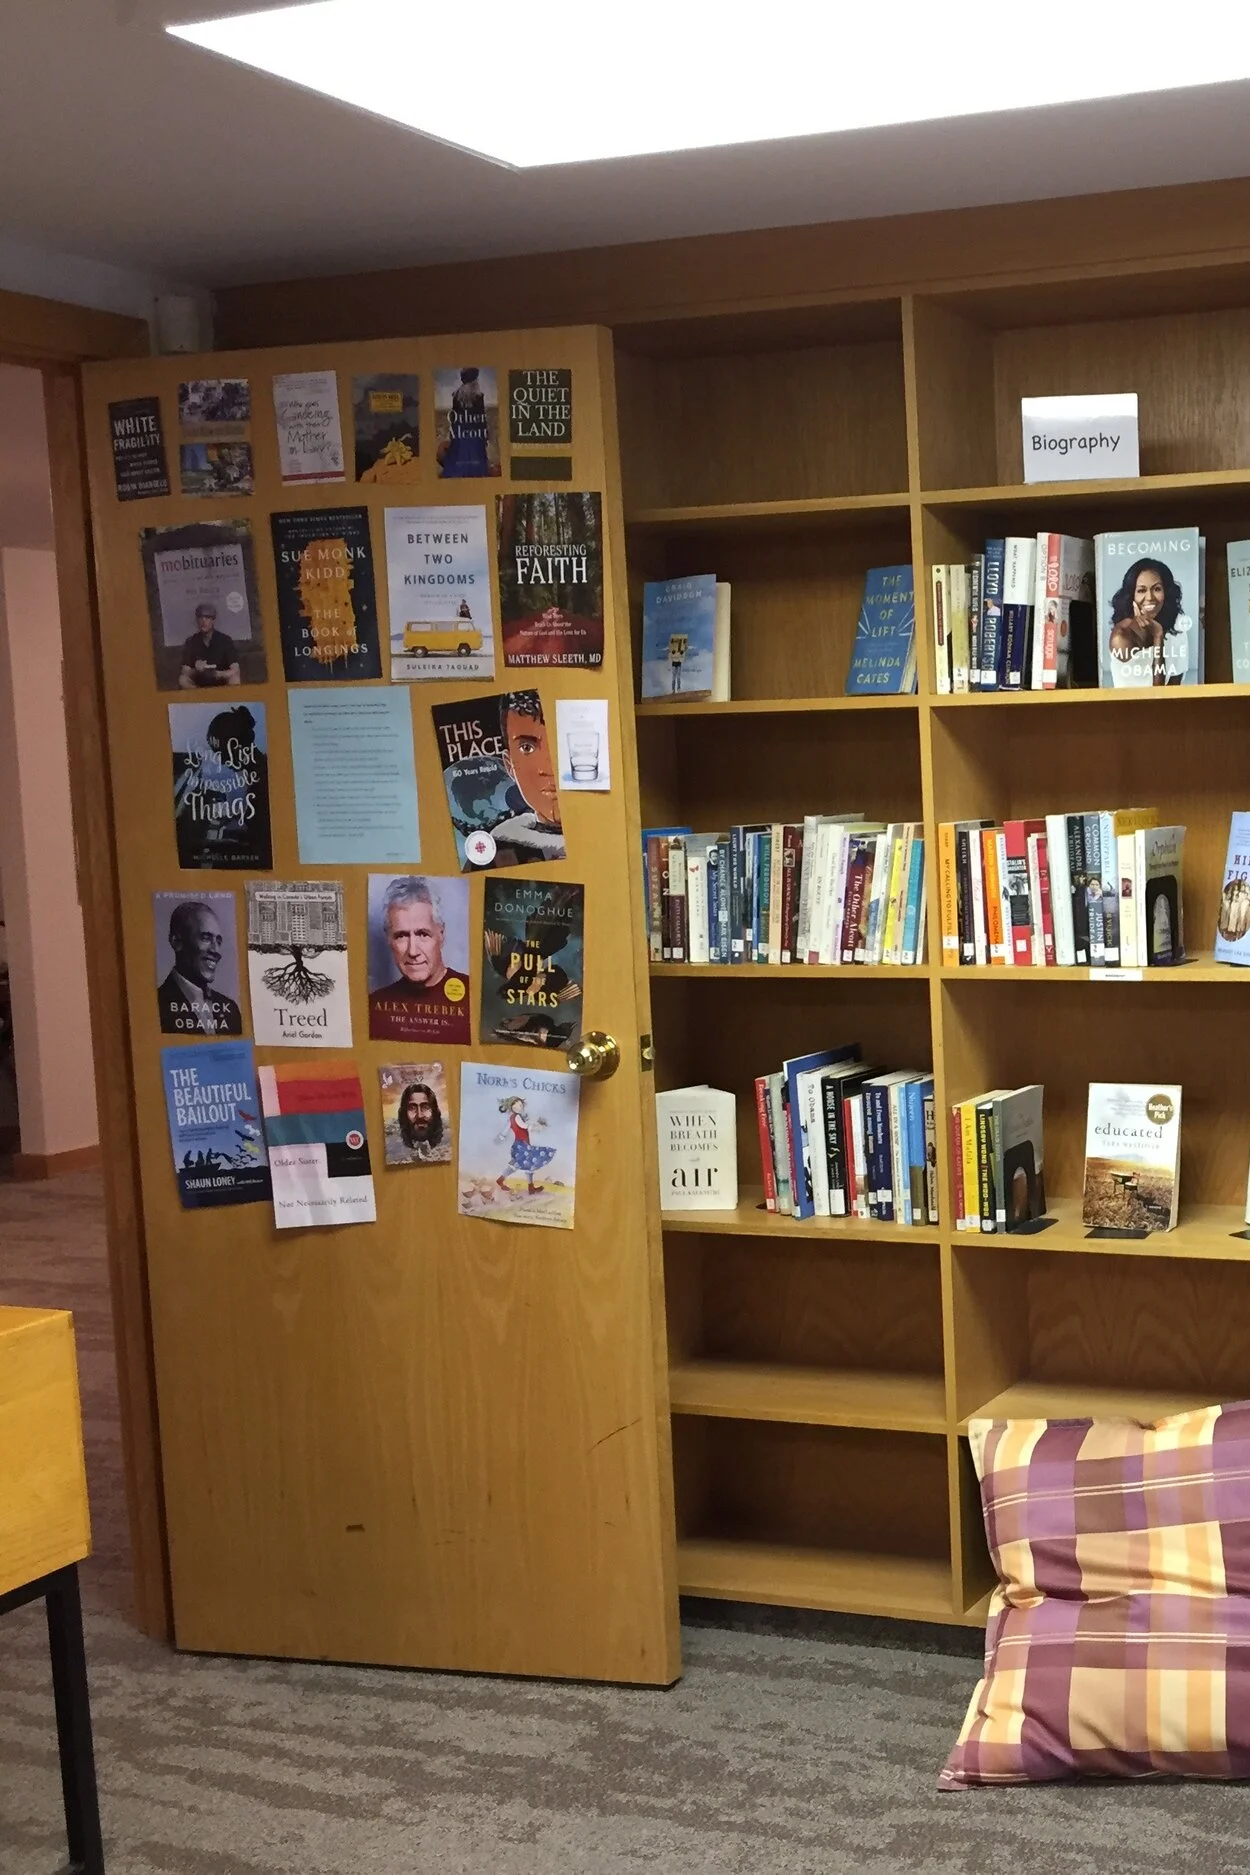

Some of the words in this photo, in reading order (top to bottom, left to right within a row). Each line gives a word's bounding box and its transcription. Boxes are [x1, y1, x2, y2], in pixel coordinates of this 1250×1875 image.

[523, 371, 558, 385] THE
[513, 387, 569, 405] QUIET
[447, 410, 487, 423] Other
[512, 404, 531, 419] IN
[538, 404, 570, 419] THE
[113, 416, 157, 437] WHITE
[447, 426, 488, 440] Alcott
[517, 422, 565, 437] LAND
[114, 433, 160, 451] FRAGILITY
[1032, 432, 1120, 455] Biography
[407, 533, 469, 544] BETWEEN
[281, 550, 312, 563] SUE
[318, 546, 366, 561] MONK
[515, 544, 587, 557] REFORESTING
[1108, 539, 1191, 555] BECOMING
[160, 552, 239, 572] mobituaries
[424, 554, 453, 564] TWO
[305, 567, 345, 580] KIDD
[516, 557, 588, 585] FAITH
[986, 561, 1000, 595] LLOYD
[404, 574, 475, 585] KINGDOMS
[882, 575, 902, 587] THE
[866, 591, 915, 605] MOMENT
[313, 609, 341, 619] THE
[880, 609, 893, 621] OF
[302, 627, 339, 638] BOOK
[871, 626, 896, 638] LIFT
[294, 643, 368, 657] LONGINGS
[1110, 645, 1187, 660] MICHELLE
[508, 654, 550, 664] MATTHEW
[589, 653, 601, 663] MD
[853, 657, 901, 669] MELINDA
[1120, 663, 1177, 677] OBAMA
[439, 720, 483, 744] THIS
[447, 736, 504, 762] PLACE
[183, 792, 256, 826] Things
[1074, 826, 1082, 871] ALEXANDRE
[1092, 824, 1100, 866] COMMON
[854, 874, 863, 892] The
[515, 889, 553, 900] EMMA
[651, 866, 659, 927] SUZANNE
[494, 903, 574, 918] DONOGHUE
[851, 894, 862, 918] Other
[1095, 912, 1103, 941] JUSTIN
[847, 922, 857, 948] Alcott
[525, 939, 540, 948] THE
[510, 952, 556, 973] PULL
[507, 989, 558, 1008] STARS
[170, 1002, 231, 1013] BARACK
[374, 1001, 409, 1013] ALEX
[415, 1003, 465, 1016] TREBEK
[175, 1018, 229, 1029] OBAMA
[274, 1007, 328, 1027] Treed
[390, 1015, 407, 1023] THE
[409, 1017, 439, 1026] ANSWER
[299, 1030, 322, 1039] Gordon
[169, 1067, 199, 1088] THE
[522, 1077, 567, 1094] CHICKS
[173, 1082, 253, 1108] BEAUTIFUL
[826, 1092, 834, 1111] HOUSE
[176, 1103, 239, 1126] BAILOUT
[808, 1097, 816, 1124] Obama
[1148, 1103, 1174, 1111] Heather's
[670, 1115, 716, 1126] WHEN
[1154, 1111, 1166, 1119] Pick
[670, 1130, 717, 1140] BREATH
[1095, 1123, 1163, 1138] educated
[670, 1144, 719, 1152] BECOMES
[185, 1178, 212, 1190] SHAUN
[671, 1168, 718, 1188] air
